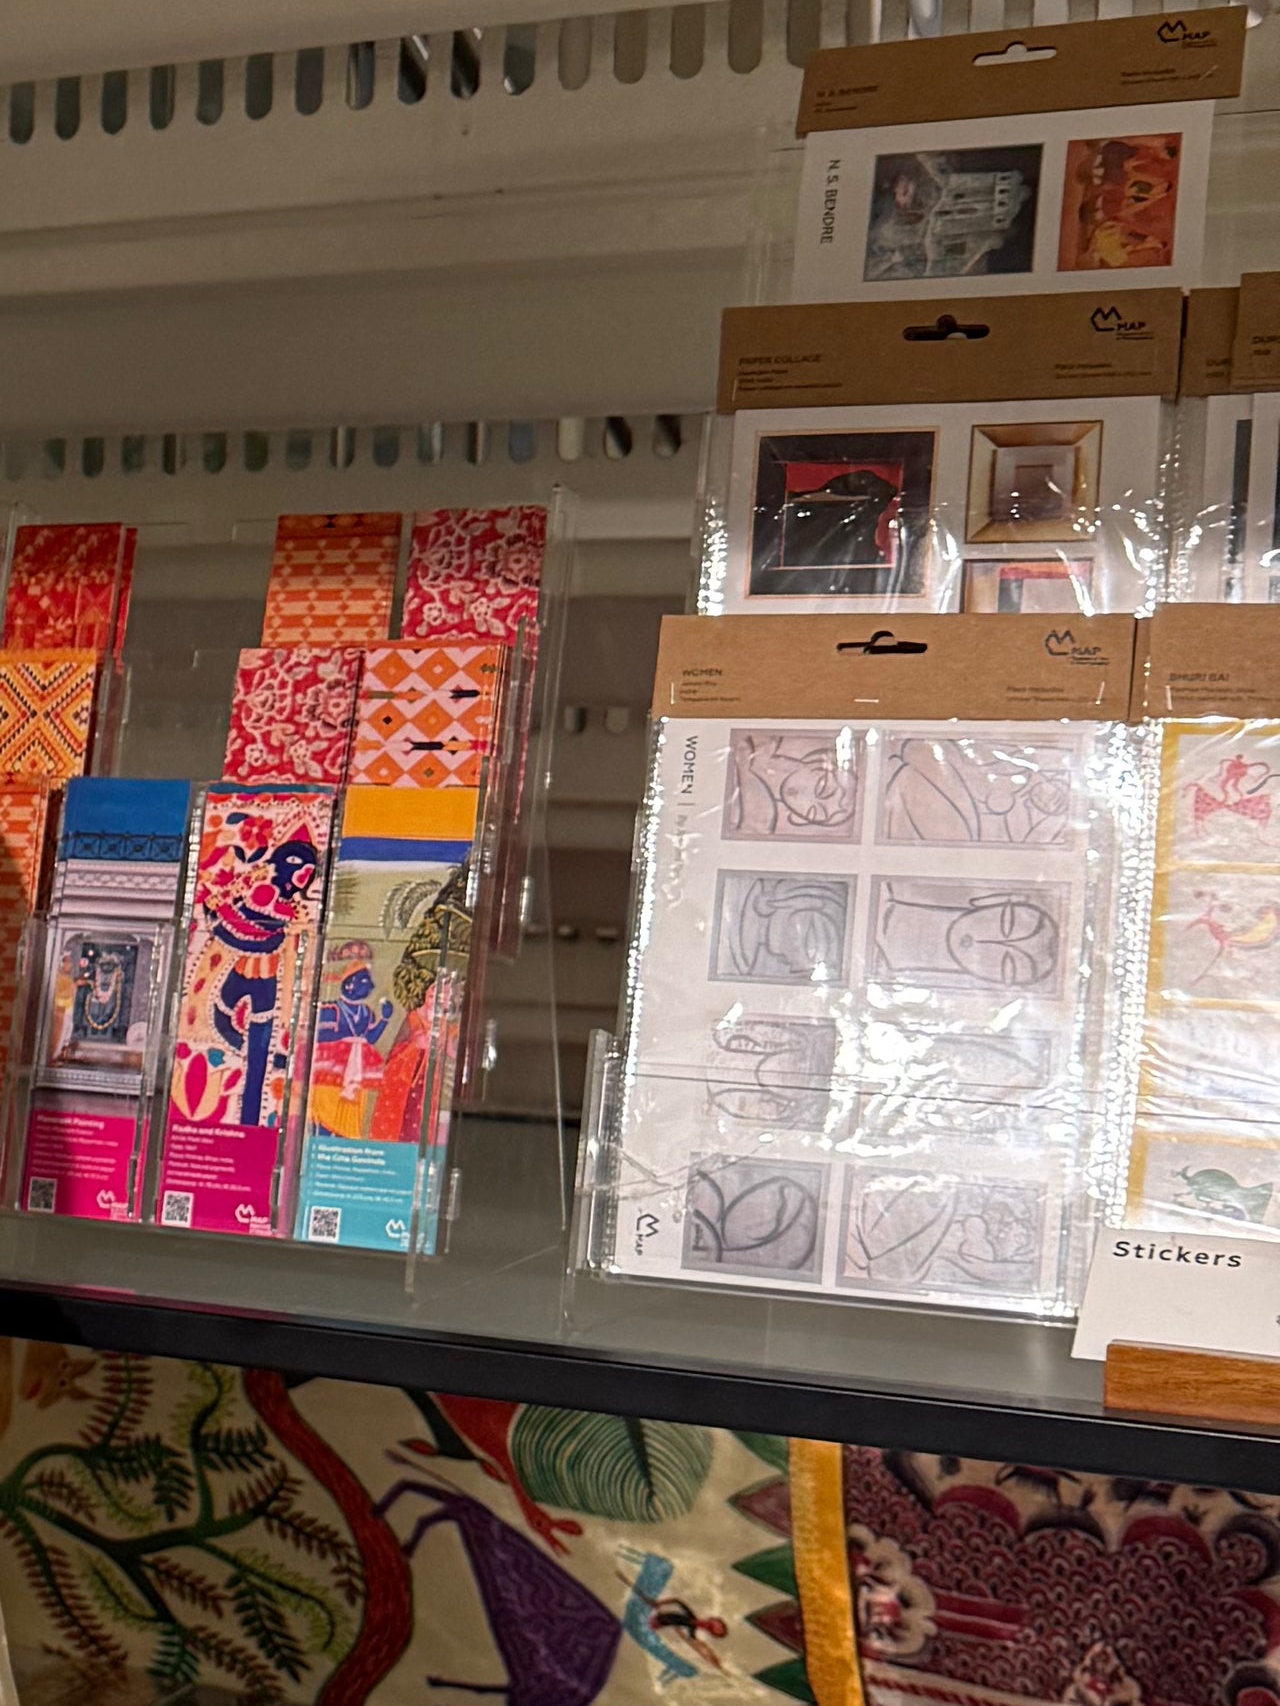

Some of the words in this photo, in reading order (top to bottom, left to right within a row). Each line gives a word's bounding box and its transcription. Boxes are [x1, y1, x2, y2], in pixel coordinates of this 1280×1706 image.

[820, 189, 838, 245] BENDRE
[681, 736, 699, 794] WOMEN
[1112, 1241, 1243, 1268] Stickers
